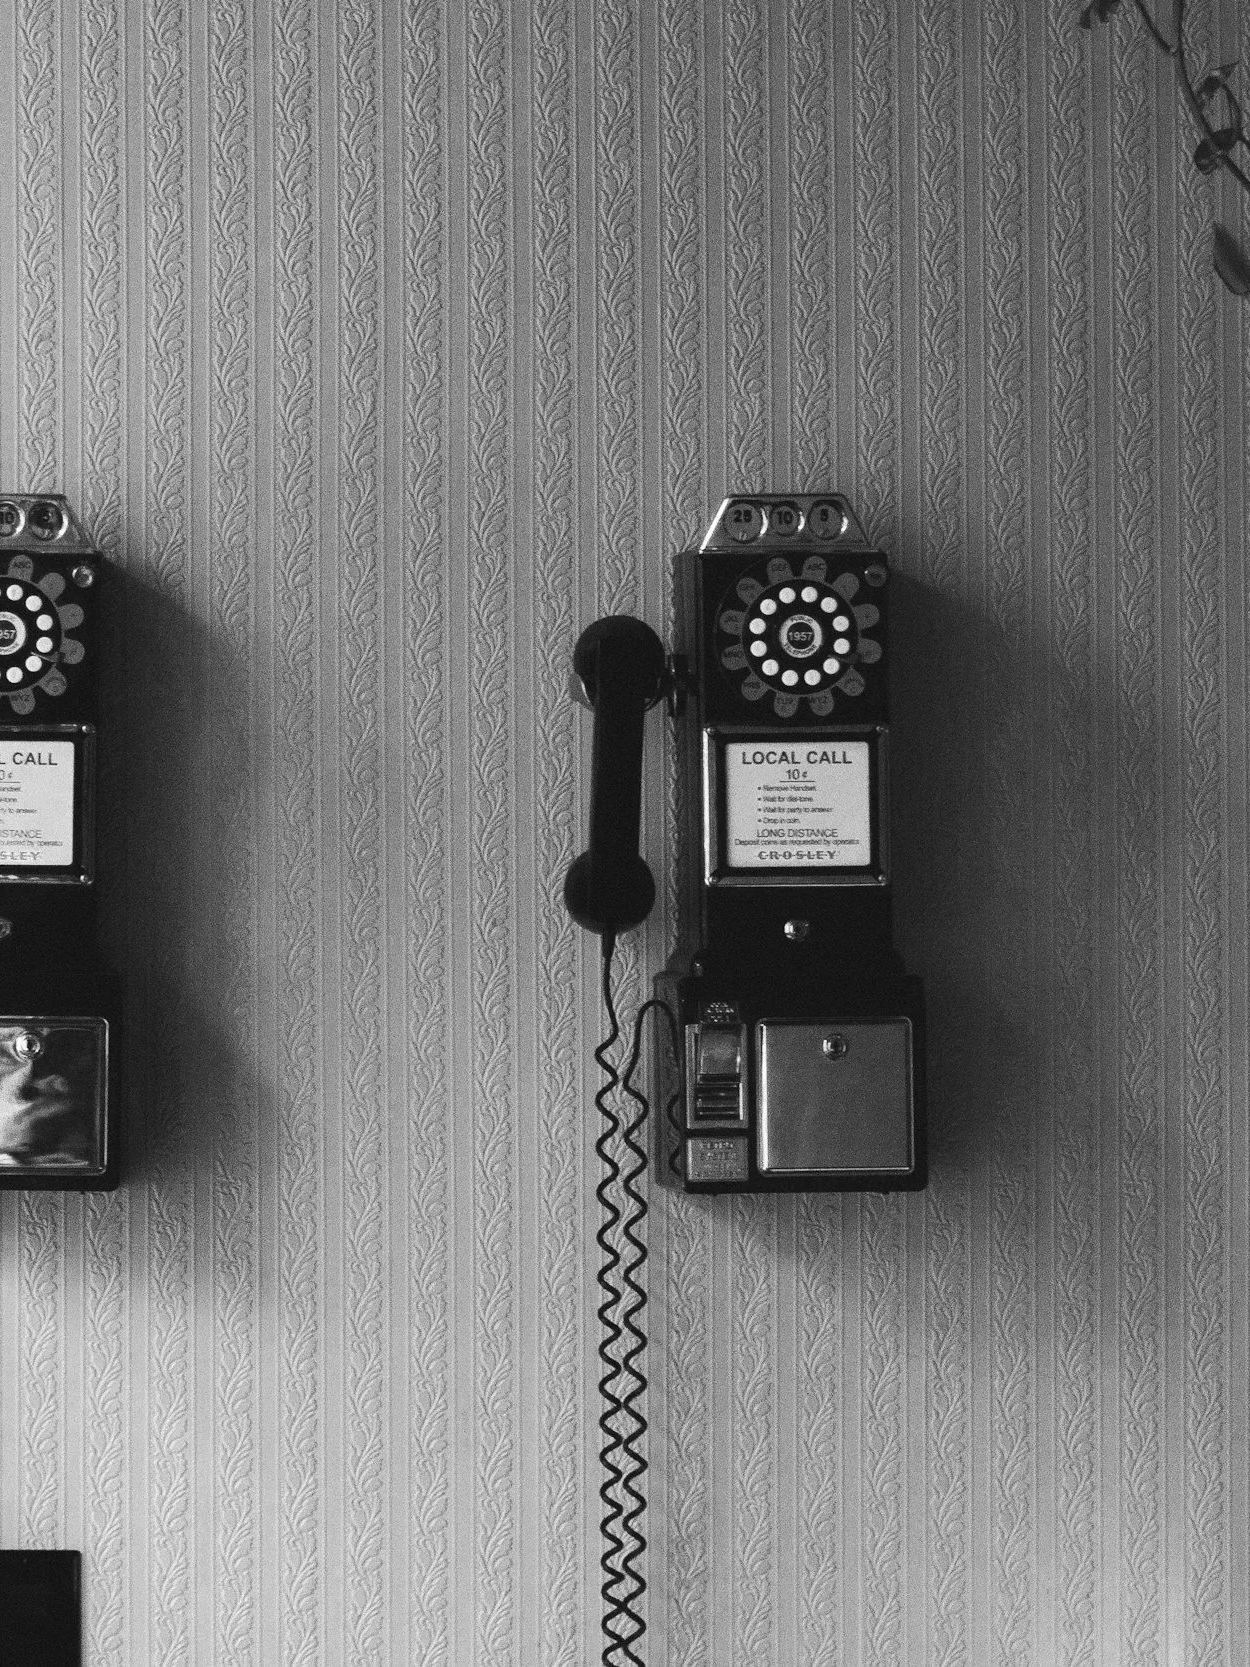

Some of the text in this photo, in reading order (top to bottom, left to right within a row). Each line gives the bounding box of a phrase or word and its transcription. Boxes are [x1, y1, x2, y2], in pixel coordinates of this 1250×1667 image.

[733, 509, 752, 523] 25
[776, 511, 794, 525] 10
[788, 631, 813, 641] 1957
[13, 752, 58, 766] CALL
[742, 751, 853, 765] LOCAL CALL
[757, 829, 838, 838] LONG DISTANCE
[758, 850, 836, 860] CROSLEY
